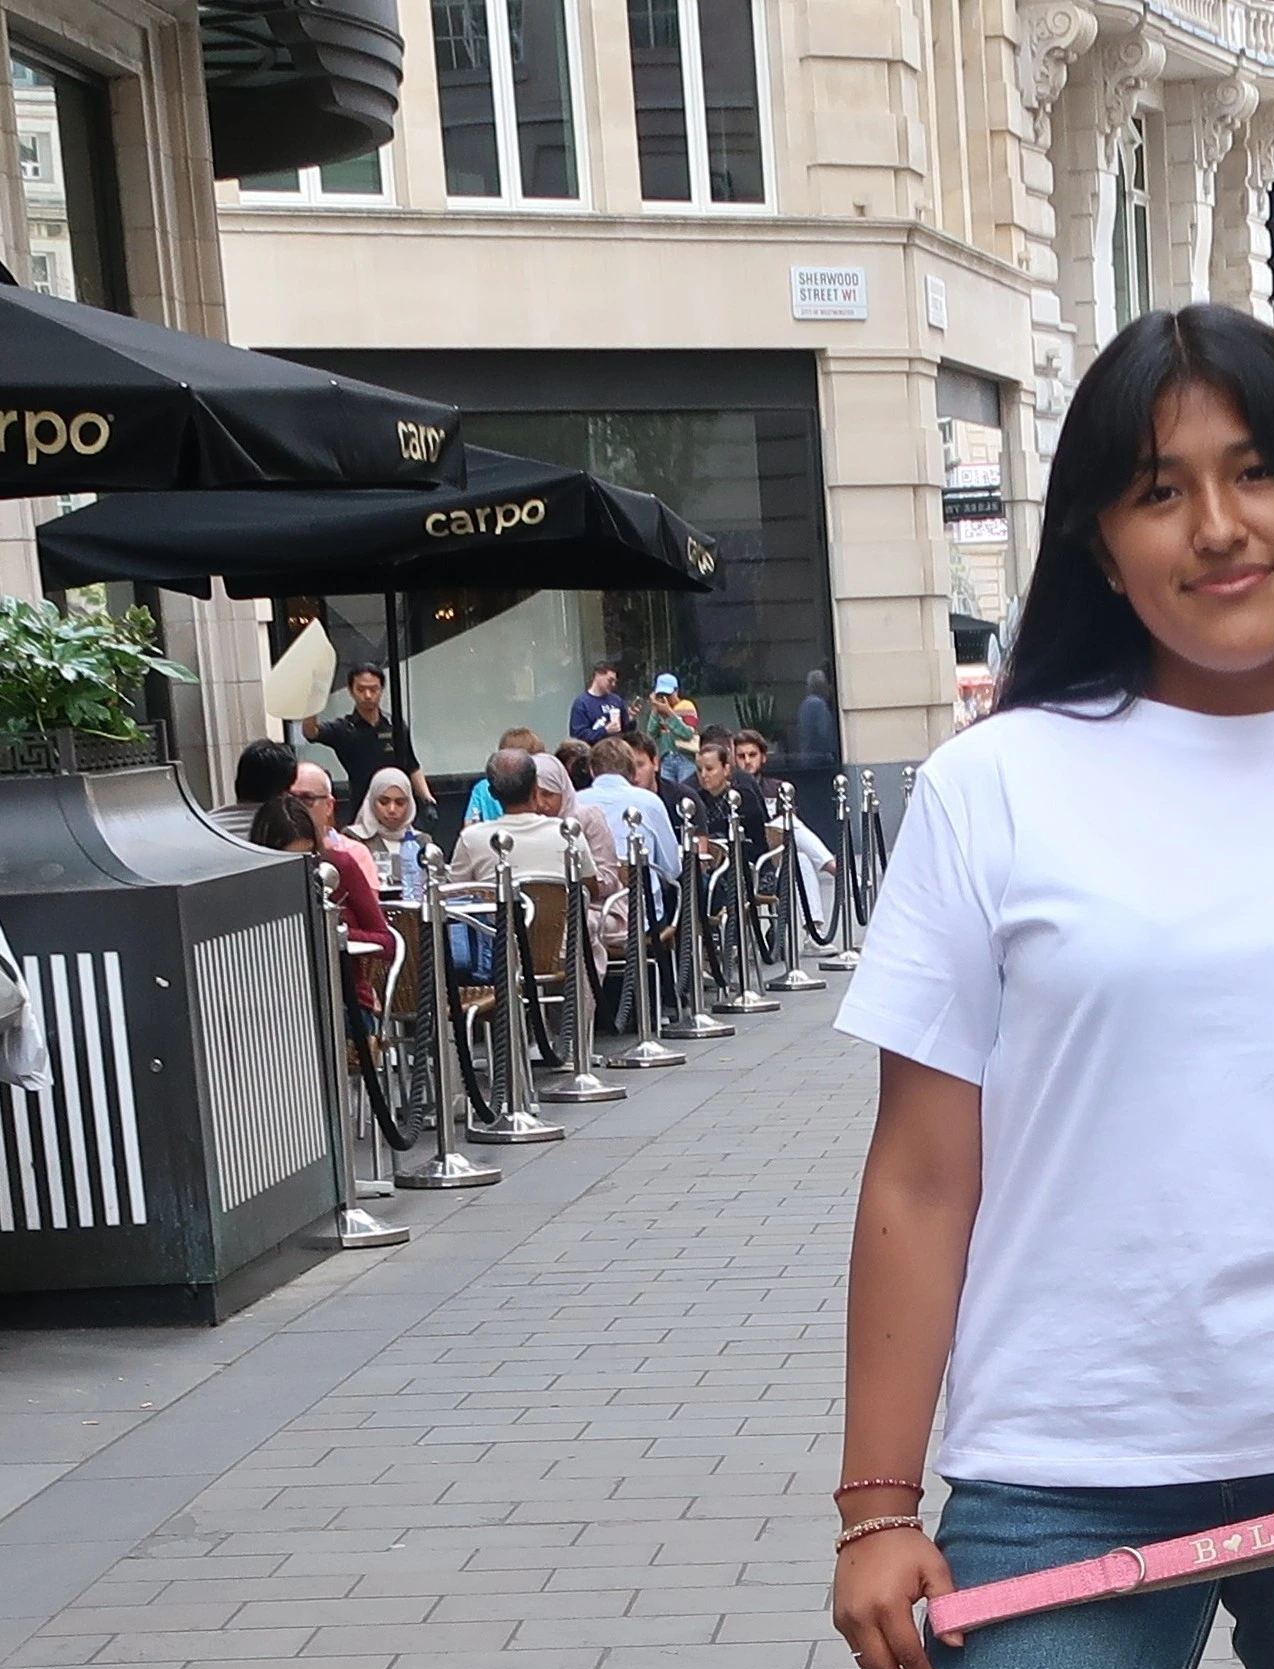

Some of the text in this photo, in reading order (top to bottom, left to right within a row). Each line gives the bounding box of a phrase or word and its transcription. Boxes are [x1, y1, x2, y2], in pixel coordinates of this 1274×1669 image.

[798, 272, 859, 287] SHERWOOD
[800, 288, 858, 302] STREET W1
[425, 499, 546, 537] carpo
